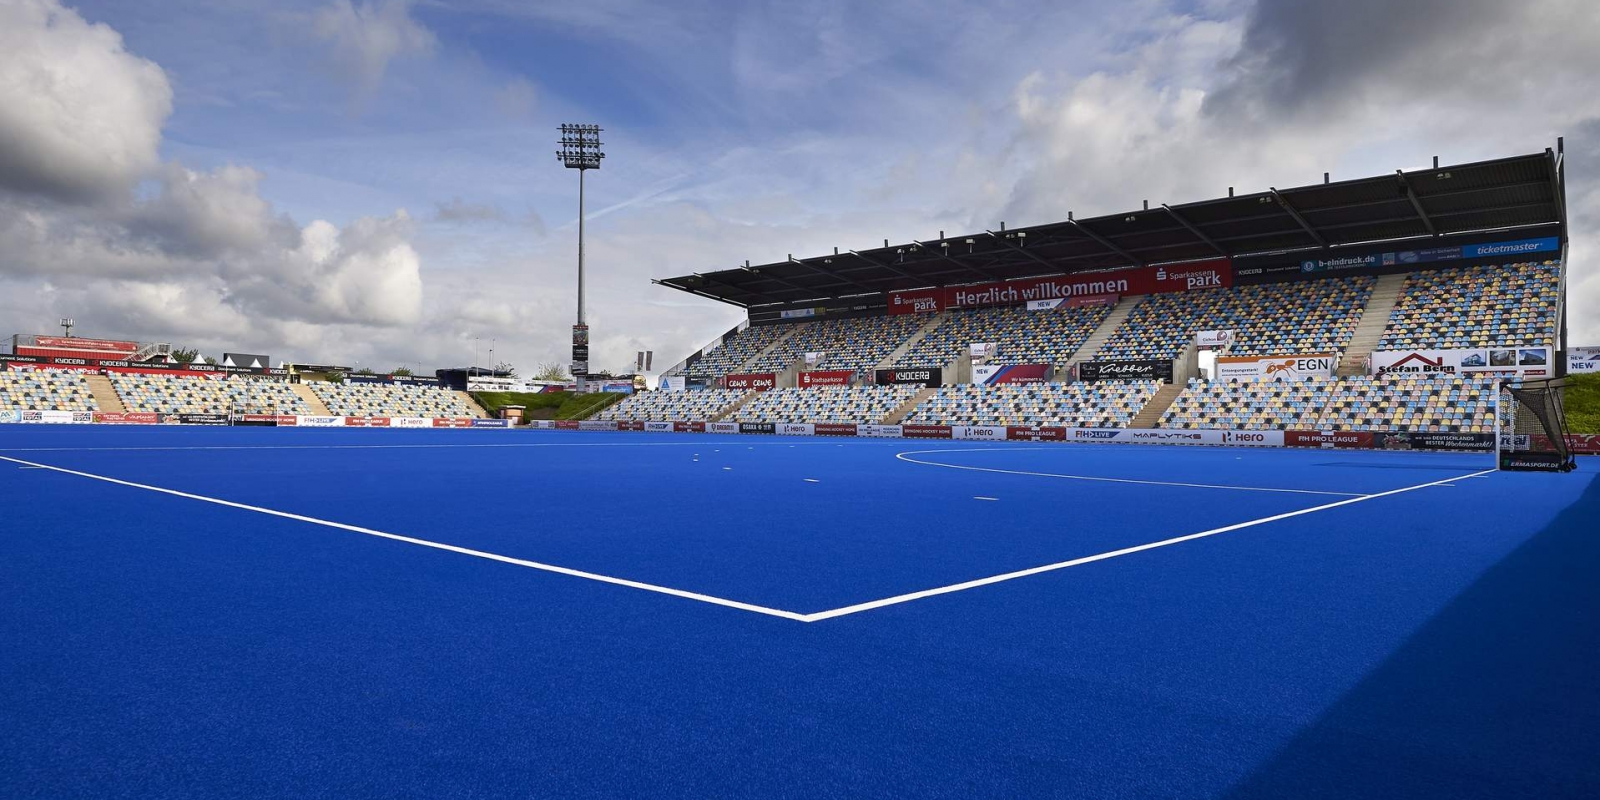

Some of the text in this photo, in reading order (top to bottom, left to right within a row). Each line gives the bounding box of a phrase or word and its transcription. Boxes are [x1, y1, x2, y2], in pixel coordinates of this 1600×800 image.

[1477, 243, 1539, 254] ticketmaster
[1318, 256, 1375, 266] b-eindruck.de
[1170, 270, 1212, 280] Sparkassen
[1188, 270, 1220, 290] park
[956, 279, 1128, 305] Herzlich willkommen
[914, 297, 937, 312] park
[1298, 359, 1328, 370] EGN
[896, 371, 930, 380] KYOCERA
